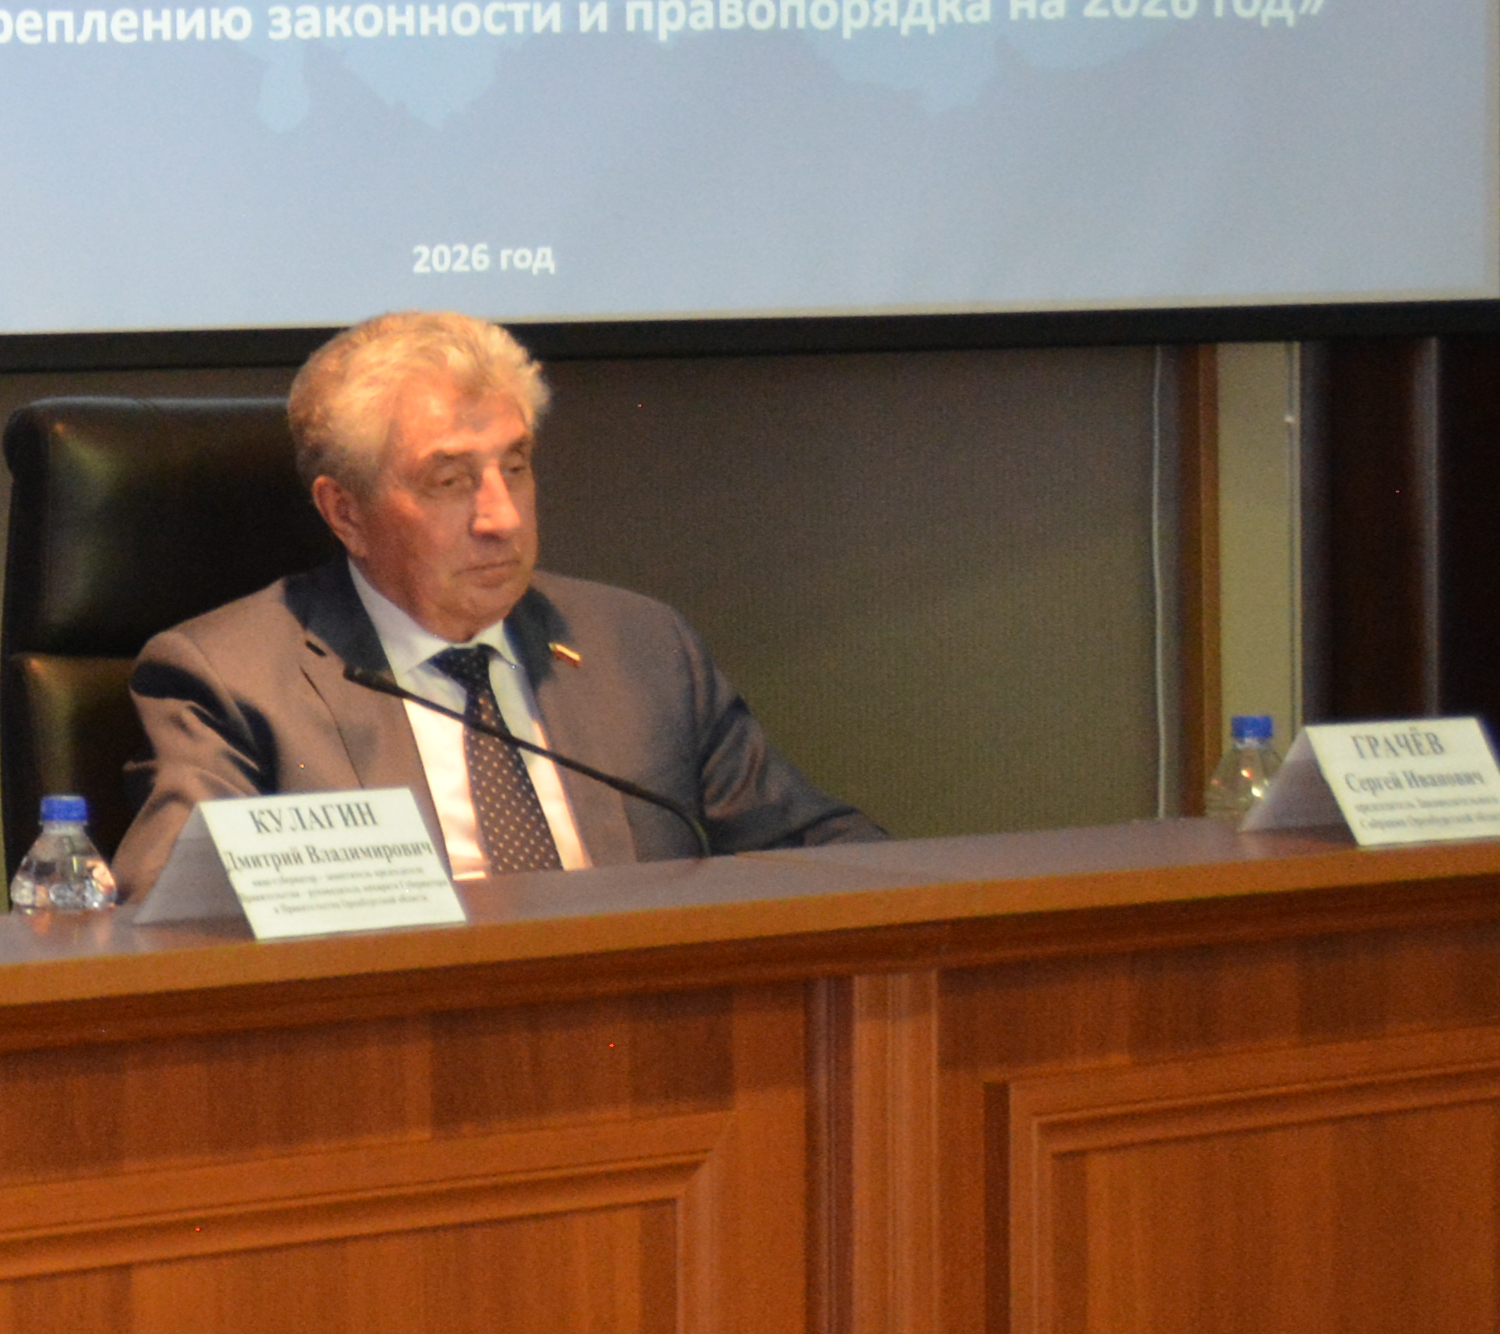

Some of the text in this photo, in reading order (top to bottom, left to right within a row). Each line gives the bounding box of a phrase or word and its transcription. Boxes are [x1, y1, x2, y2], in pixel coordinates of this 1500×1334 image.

[268, 0, 561, 39] законности
[581, 0, 607, 33] и
[413, 243, 555, 275] 2026 год
[248, 801, 377, 834] КУЛАГИН
